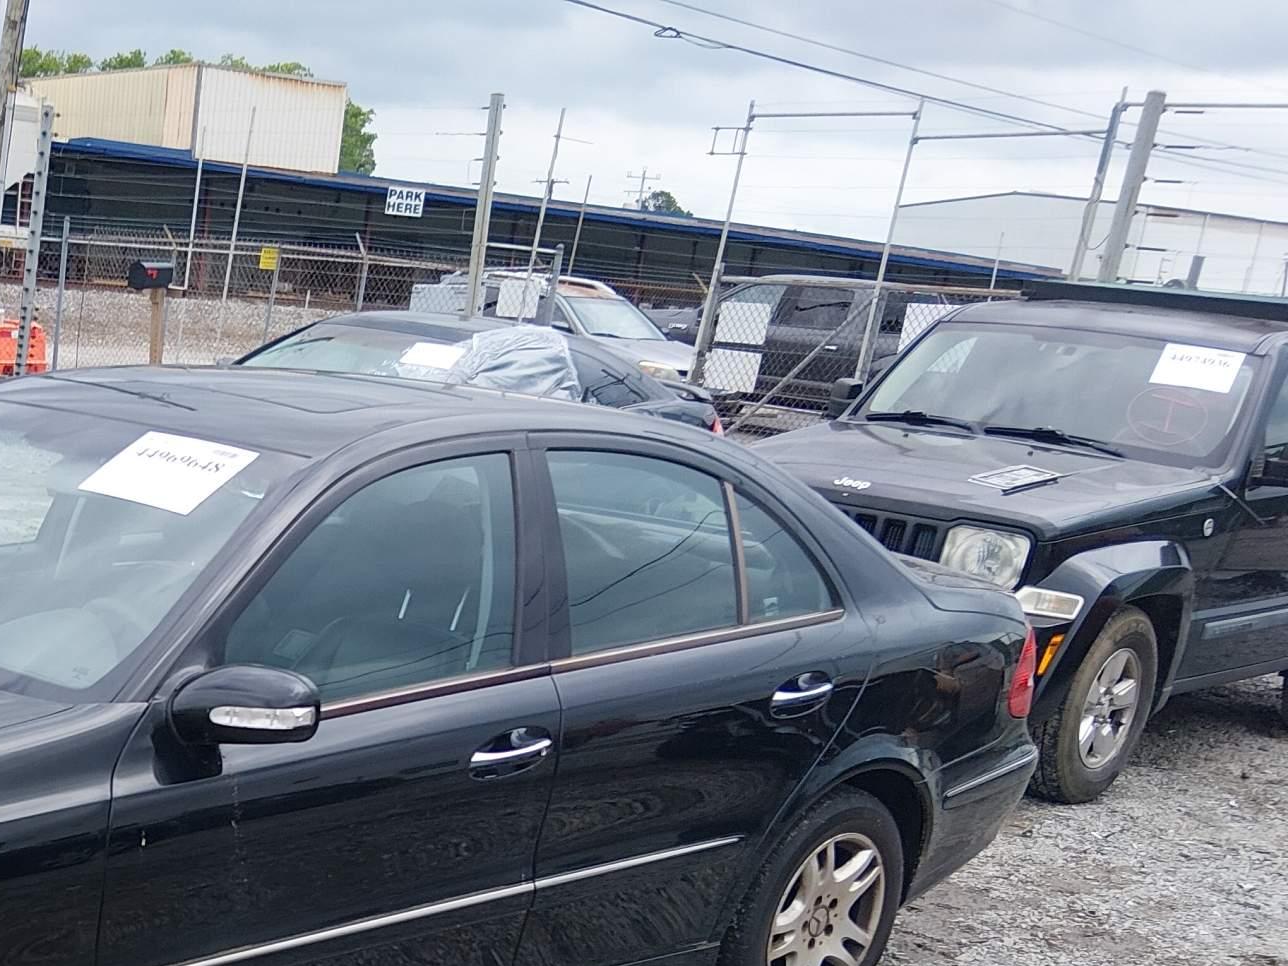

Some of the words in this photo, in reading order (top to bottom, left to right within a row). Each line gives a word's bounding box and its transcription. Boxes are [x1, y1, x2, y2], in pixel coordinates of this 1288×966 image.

[388, 189, 423, 202] PARK
[386, 201, 422, 214] HERE
[833, 476, 872, 490] Jeep
